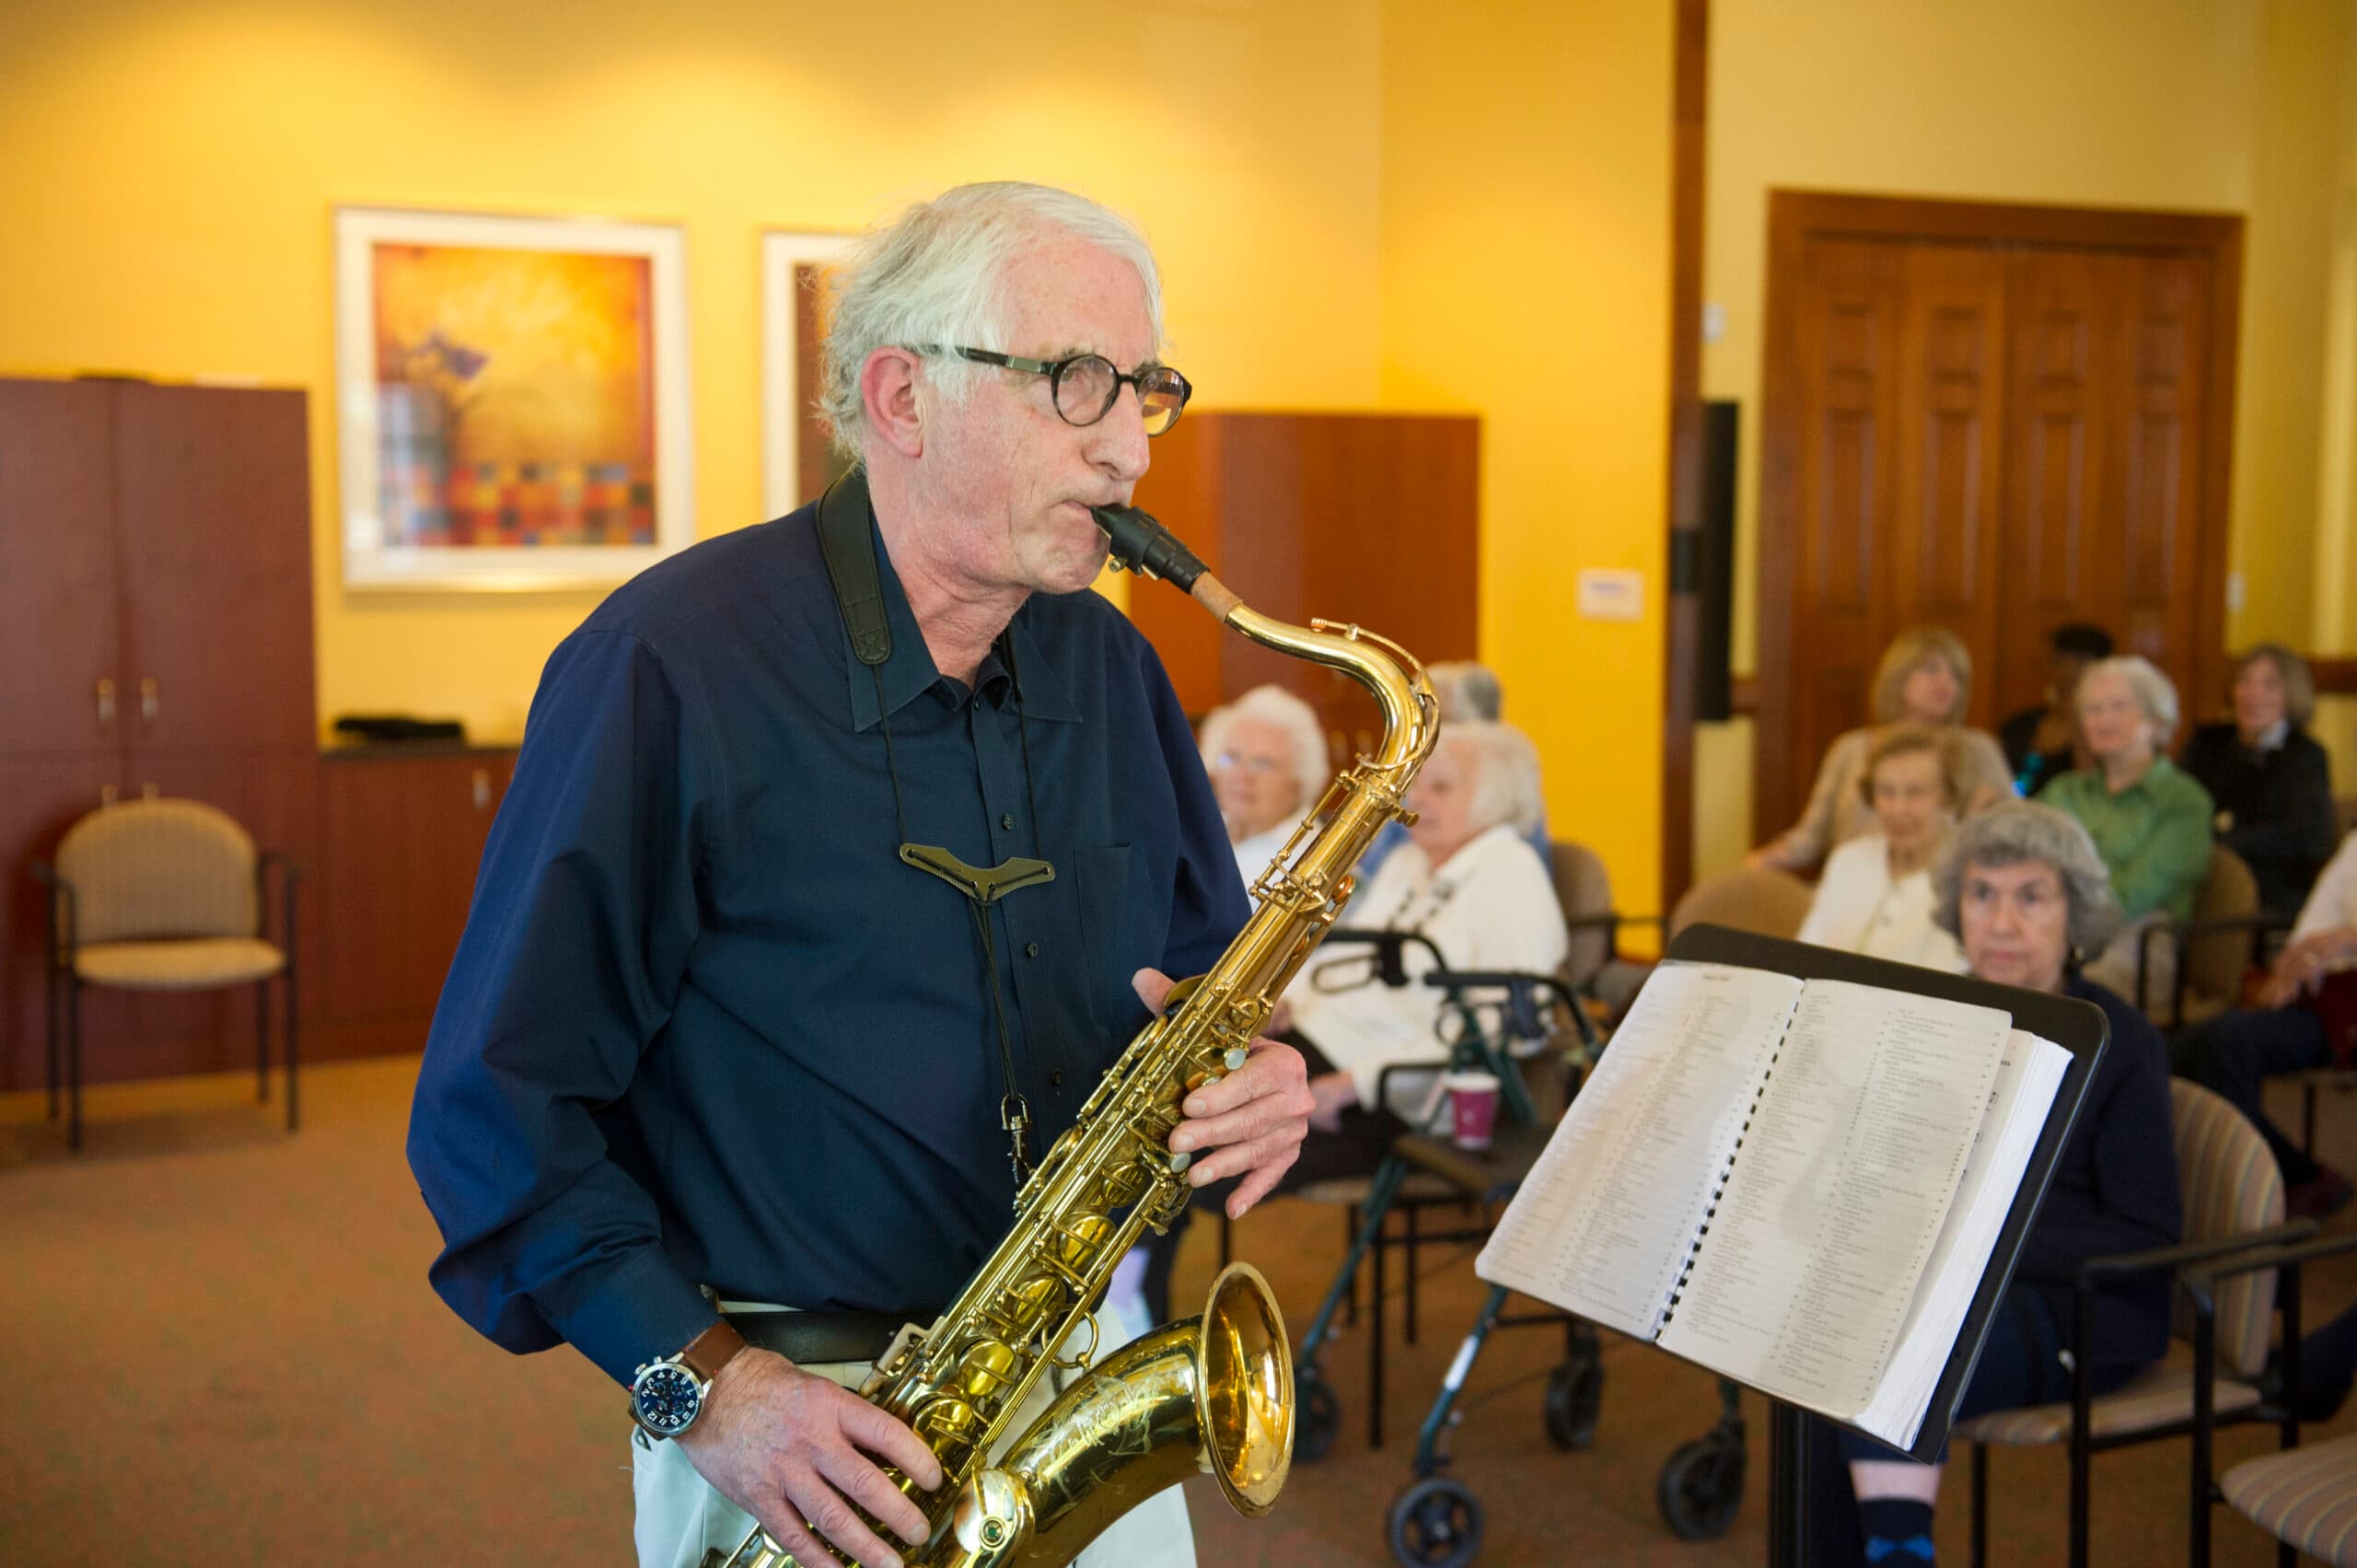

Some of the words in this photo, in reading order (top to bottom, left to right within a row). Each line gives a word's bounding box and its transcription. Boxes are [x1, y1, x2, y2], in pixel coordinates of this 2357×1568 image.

[669, 1371, 678, 1379] 5
[646, 1377, 655, 1387] 3
[641, 1389, 650, 1398] 2
[687, 1400, 695, 1408] 8
[647, 1411, 657, 1422] 12
[670, 1414, 680, 1426] 10
[659, 1417, 667, 1426] 11
